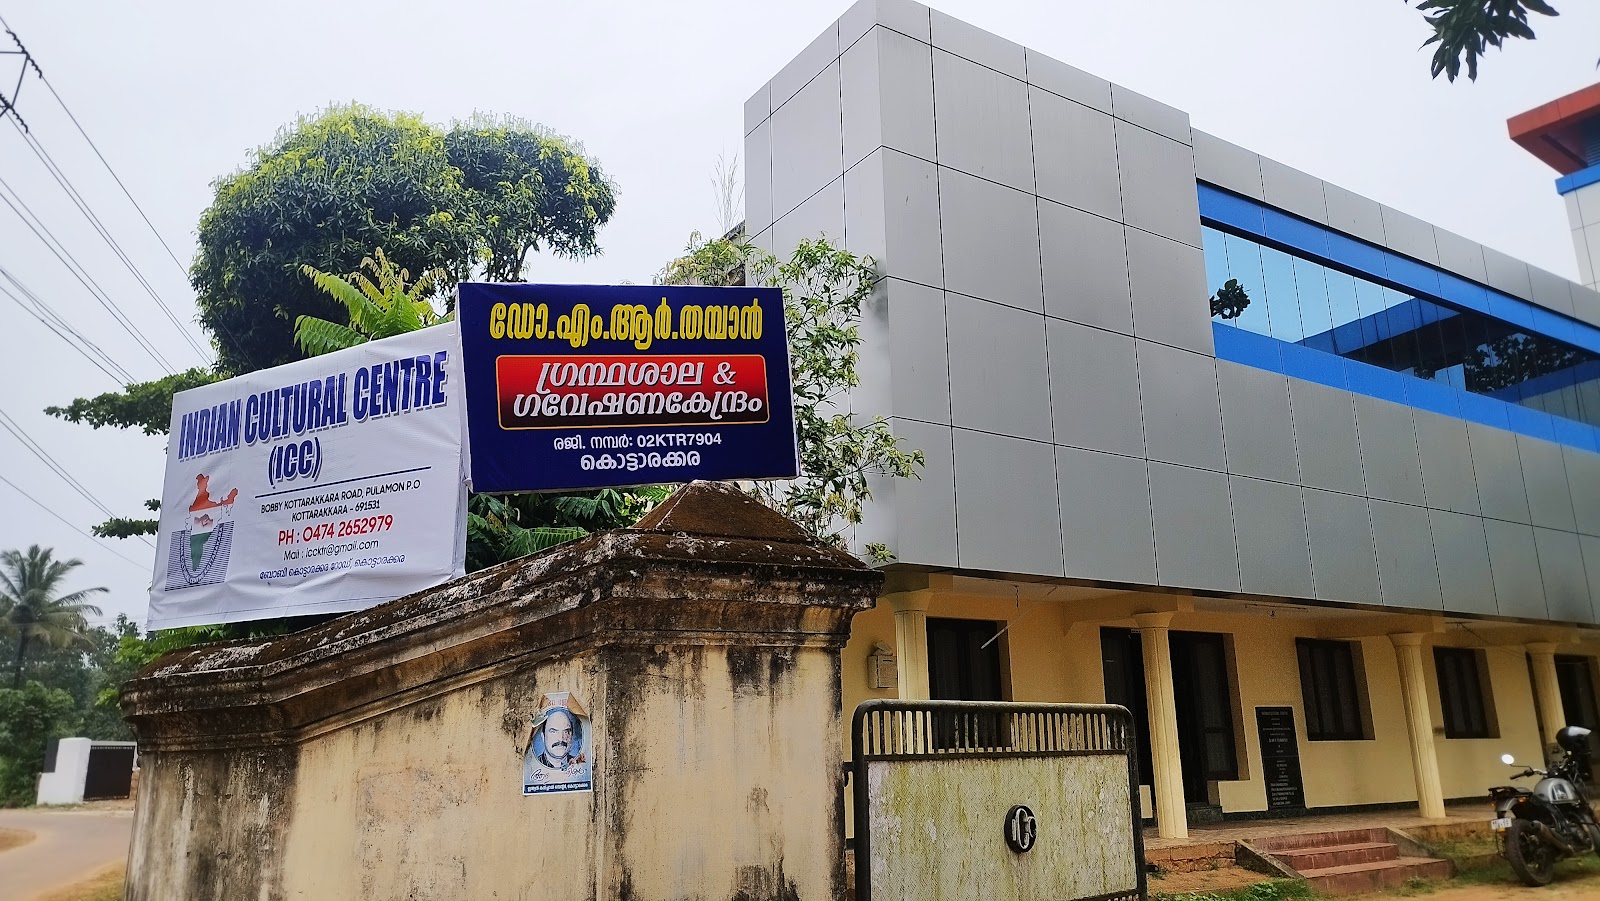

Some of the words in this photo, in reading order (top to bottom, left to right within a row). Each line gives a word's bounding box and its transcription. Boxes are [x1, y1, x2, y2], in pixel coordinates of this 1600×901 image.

[536, 361, 705, 395] ഗ്രന്ഥശാല
[712, 362, 737, 385] &
[178, 398, 242, 461] INDIAN
[243, 371, 349, 446] CULTURAL
[352, 350, 450, 422] CENTRE
[513, 390, 763, 420] ഗവേഷണകേന്ദ്രം
[636, 432, 722, 448] 02KTR7904
[268, 436, 324, 488] (ICC)
[580, 451, 701, 472] കൊട്ടാരക്കര
[261, 502, 284, 514] BOBBY
[283, 492, 340, 510] KOTTARAKKARA
[341, 488, 364, 501] ROAD,
[365, 481, 405, 497] PULAMON
[406, 479, 421, 490] P.O
[291, 504, 348, 522] KOTTARAKKARA
[355, 499, 381, 513] 691531
[278, 528, 294, 546] PH
[338, 514, 394, 537] 2652979
[283, 549, 300, 561] Mail
